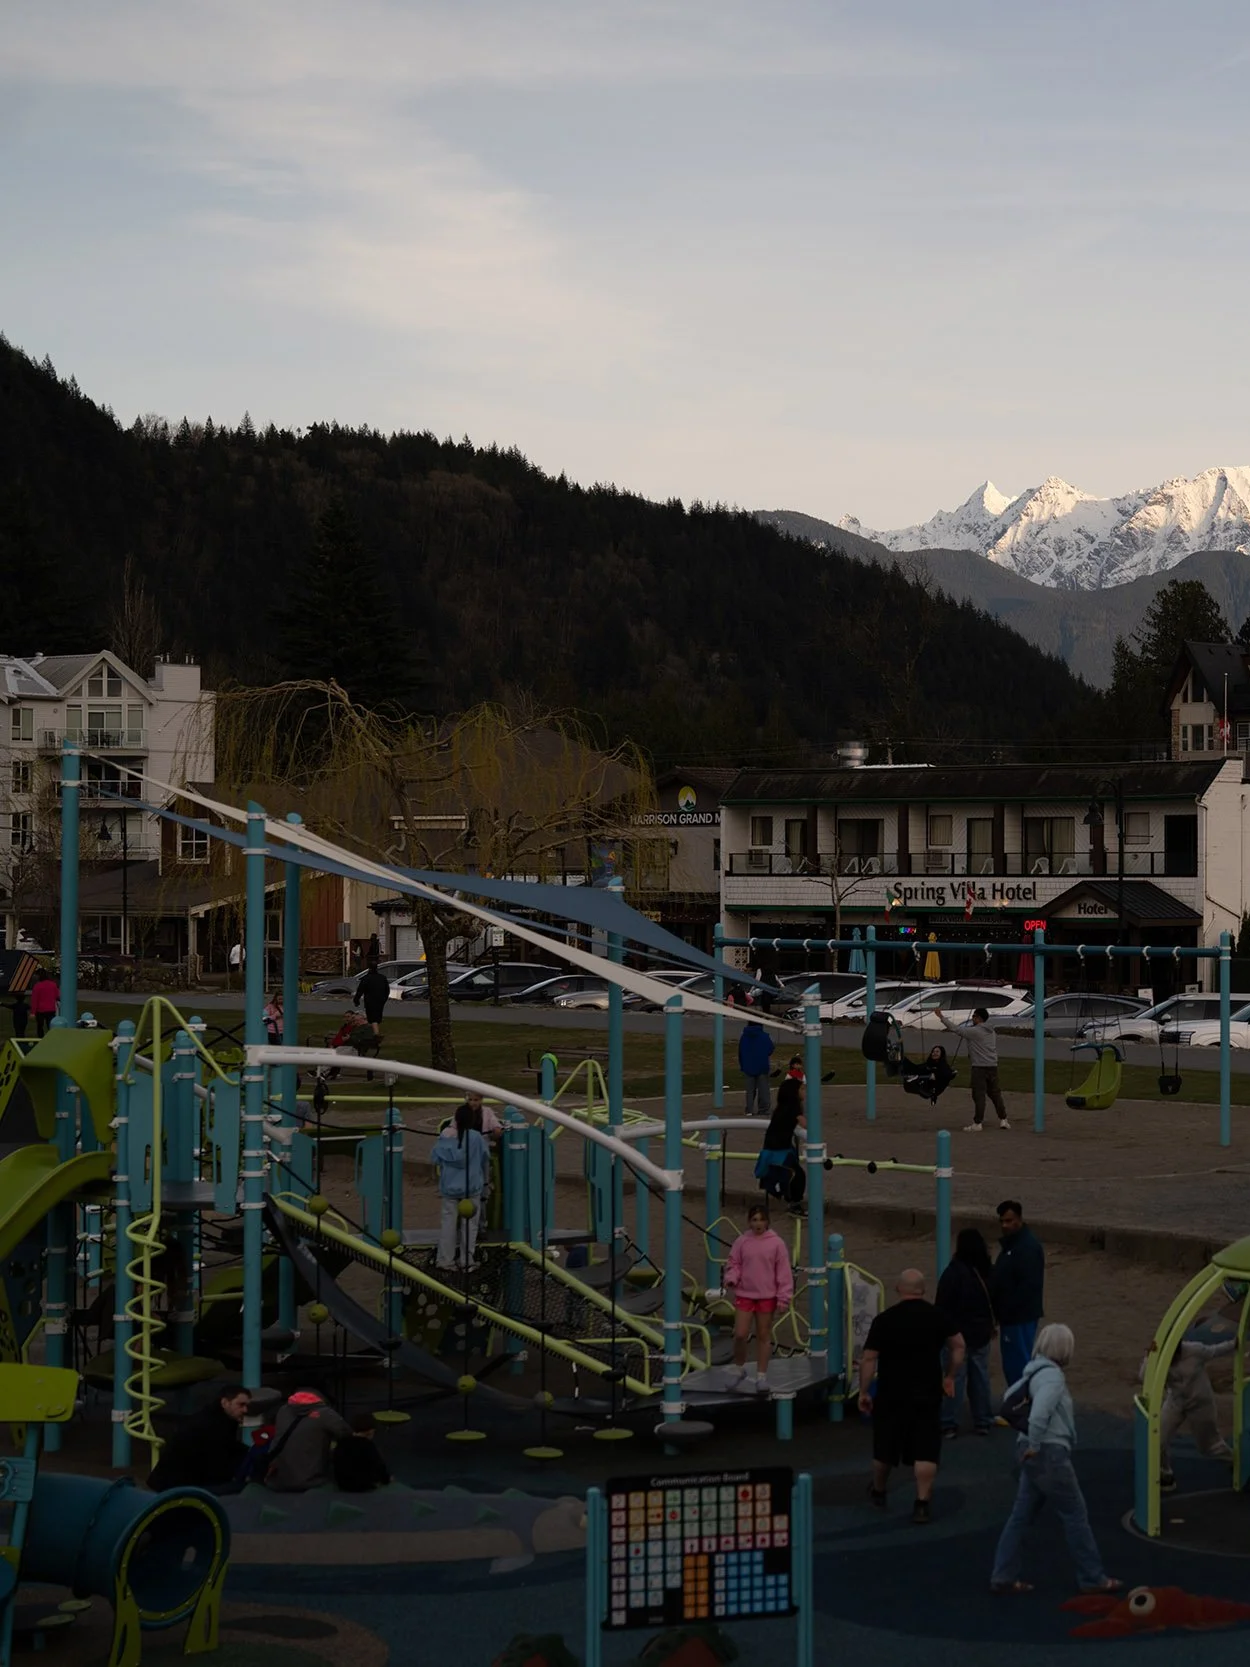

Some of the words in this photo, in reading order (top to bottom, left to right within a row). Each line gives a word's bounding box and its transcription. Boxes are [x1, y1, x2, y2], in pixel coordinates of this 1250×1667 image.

[630, 813, 677, 825] HARRISON
[679, 812, 713, 825] GRAND
[893, 881, 946, 906] Spring
[950, 881, 987, 900] Vila
[992, 881, 1036, 900] Hotel
[1077, 902, 1108, 915] Hotel
[1024, 919, 1047, 931] OPEN
[649, 1474, 721, 1488] Communication
[722, 1471, 751, 1483] Board
